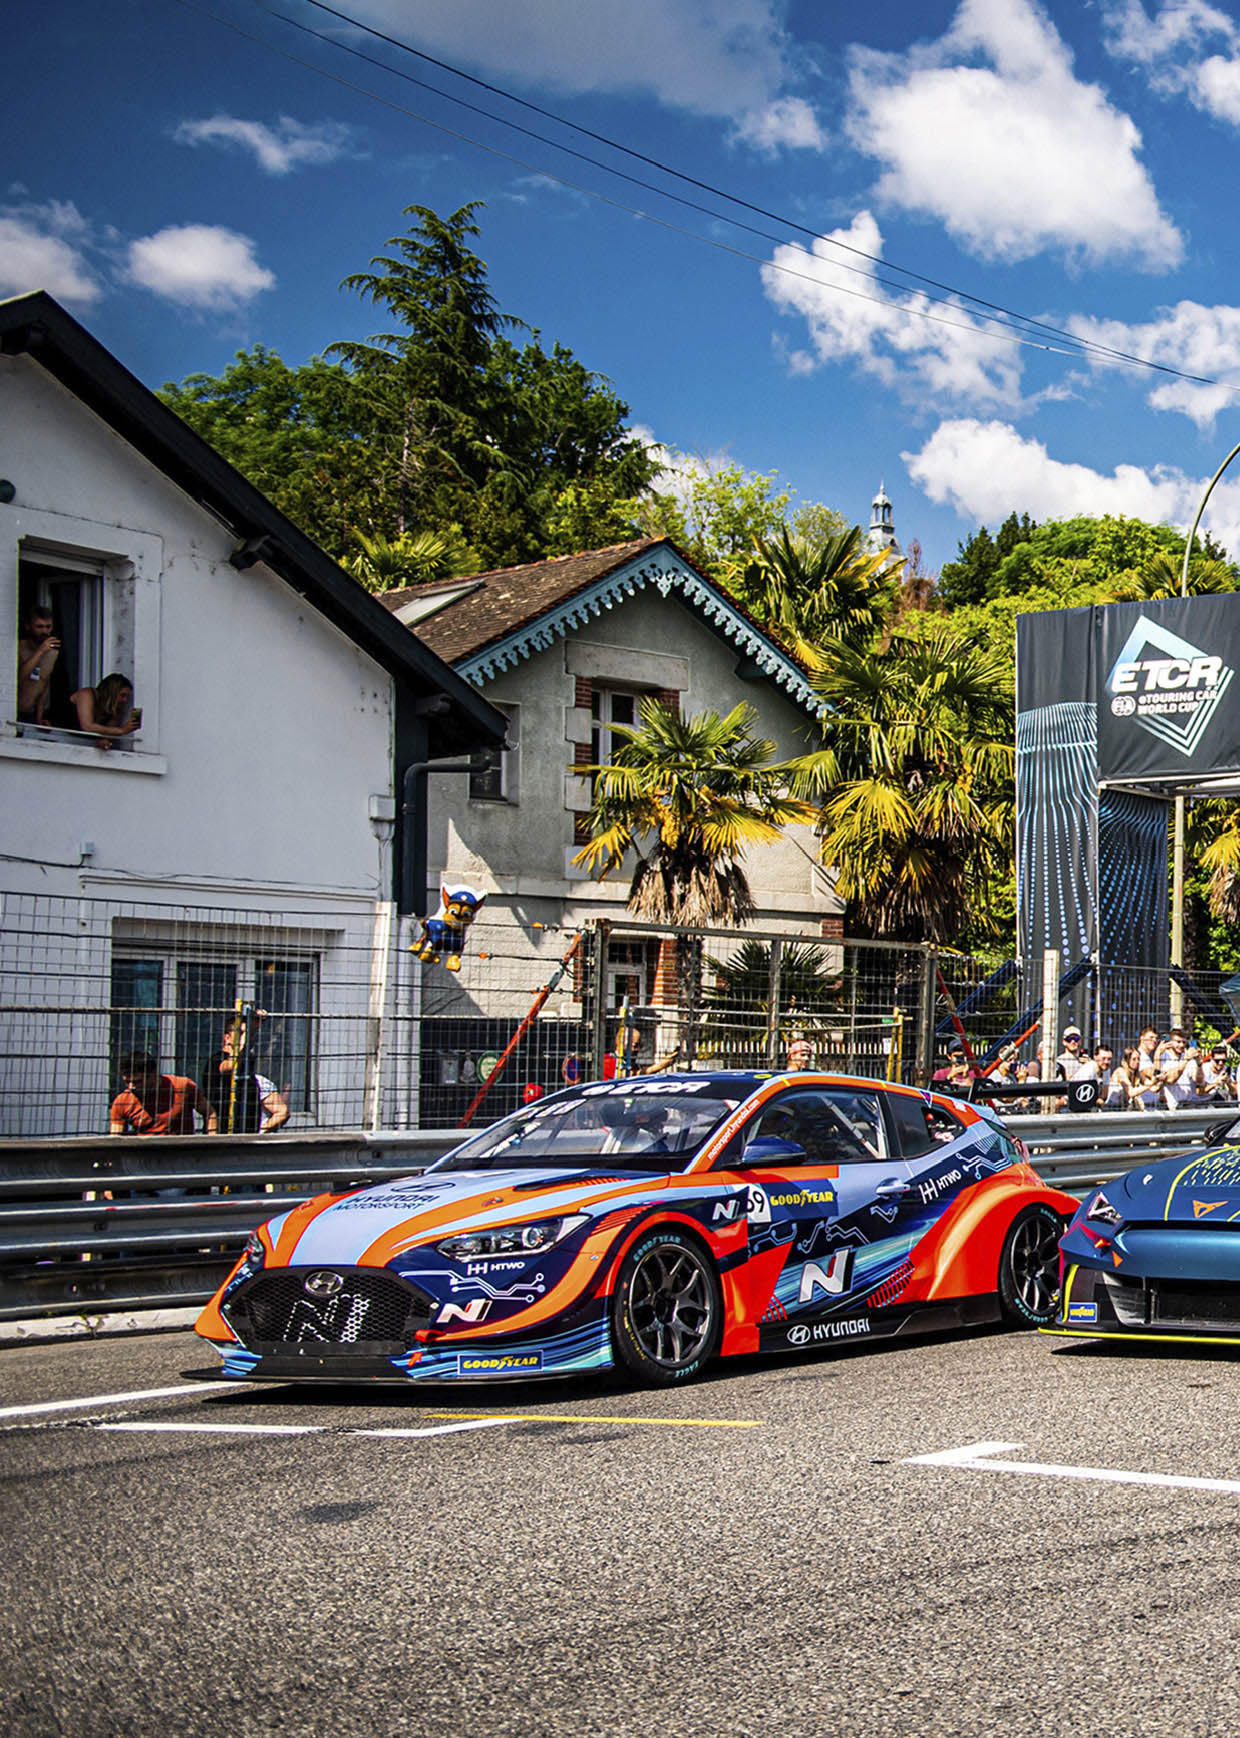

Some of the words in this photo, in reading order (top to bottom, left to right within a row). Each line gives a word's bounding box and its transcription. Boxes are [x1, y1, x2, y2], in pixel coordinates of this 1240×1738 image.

[1111, 656, 1222, 693] ETCR
[1195, 690, 1217, 701] CAR
[1137, 702, 1177, 715] WORLD
[1178, 701, 1199, 713] CUP
[608, 1081, 711, 1095] ETCR
[936, 1169, 962, 1190] HTWO
[770, 1189, 834, 1207] GOODYEAR
[490, 1261, 526, 1272] HTWO
[812, 1318, 871, 1340] HYUNDAI
[462, 1356, 539, 1370] GOODYEAR
